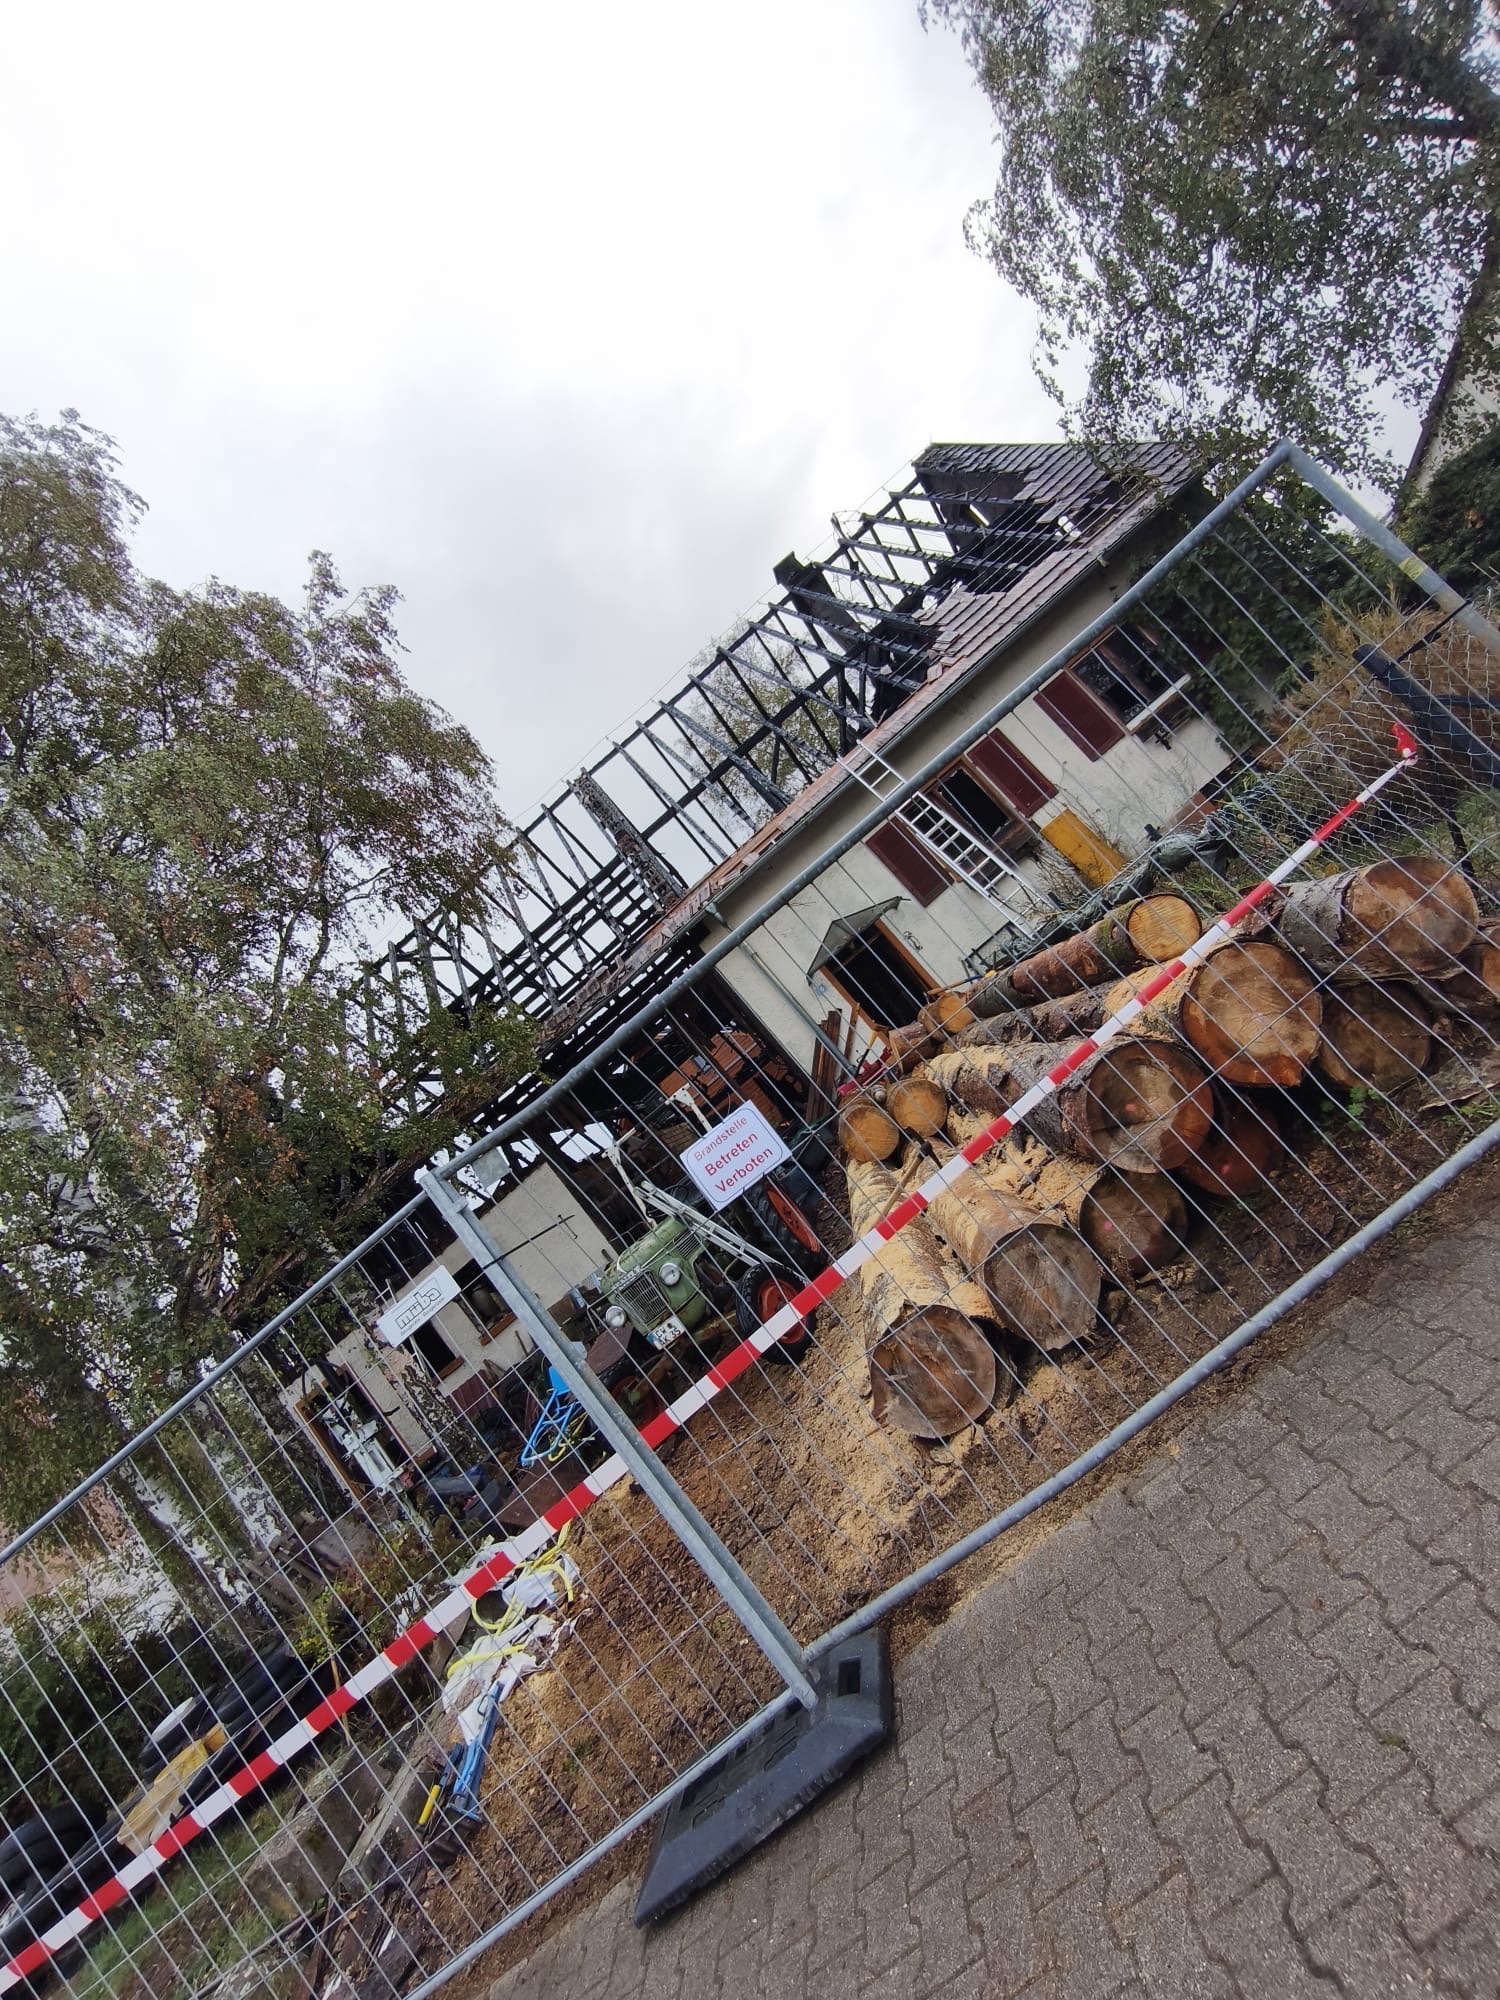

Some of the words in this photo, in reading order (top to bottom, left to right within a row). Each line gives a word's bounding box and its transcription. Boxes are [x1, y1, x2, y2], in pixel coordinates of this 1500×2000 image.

[694, 1117, 748, 1161] Brandstelle
[704, 1132, 758, 1176] Betreten
[715, 1148, 773, 1192] Verboten
